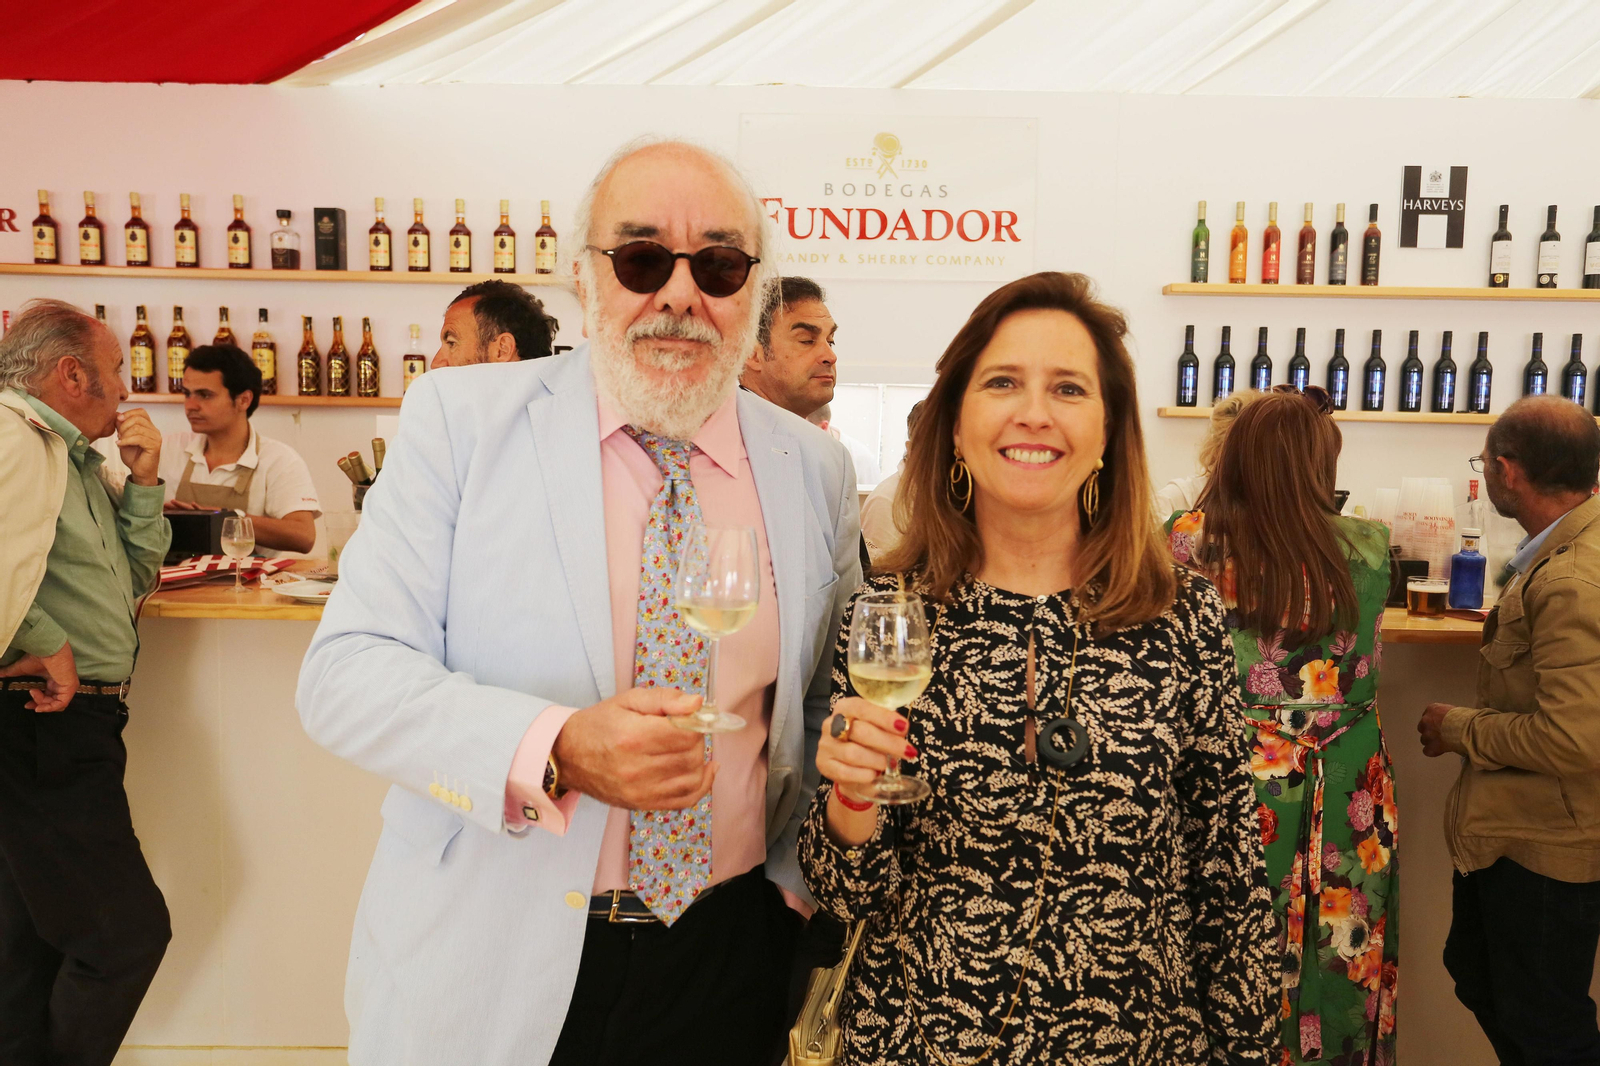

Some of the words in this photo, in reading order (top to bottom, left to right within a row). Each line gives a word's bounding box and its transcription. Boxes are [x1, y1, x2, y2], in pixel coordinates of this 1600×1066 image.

[901, 159, 928, 168] 1730
[824, 182, 949, 198] BODEGAS
[1403, 198, 1465, 211] HARVEYS
[776, 252, 830, 264] RANDY
[838, 254, 848, 264] &
[858, 254, 918, 265] SHERRY
[926, 255, 1006, 267] COMPANY
